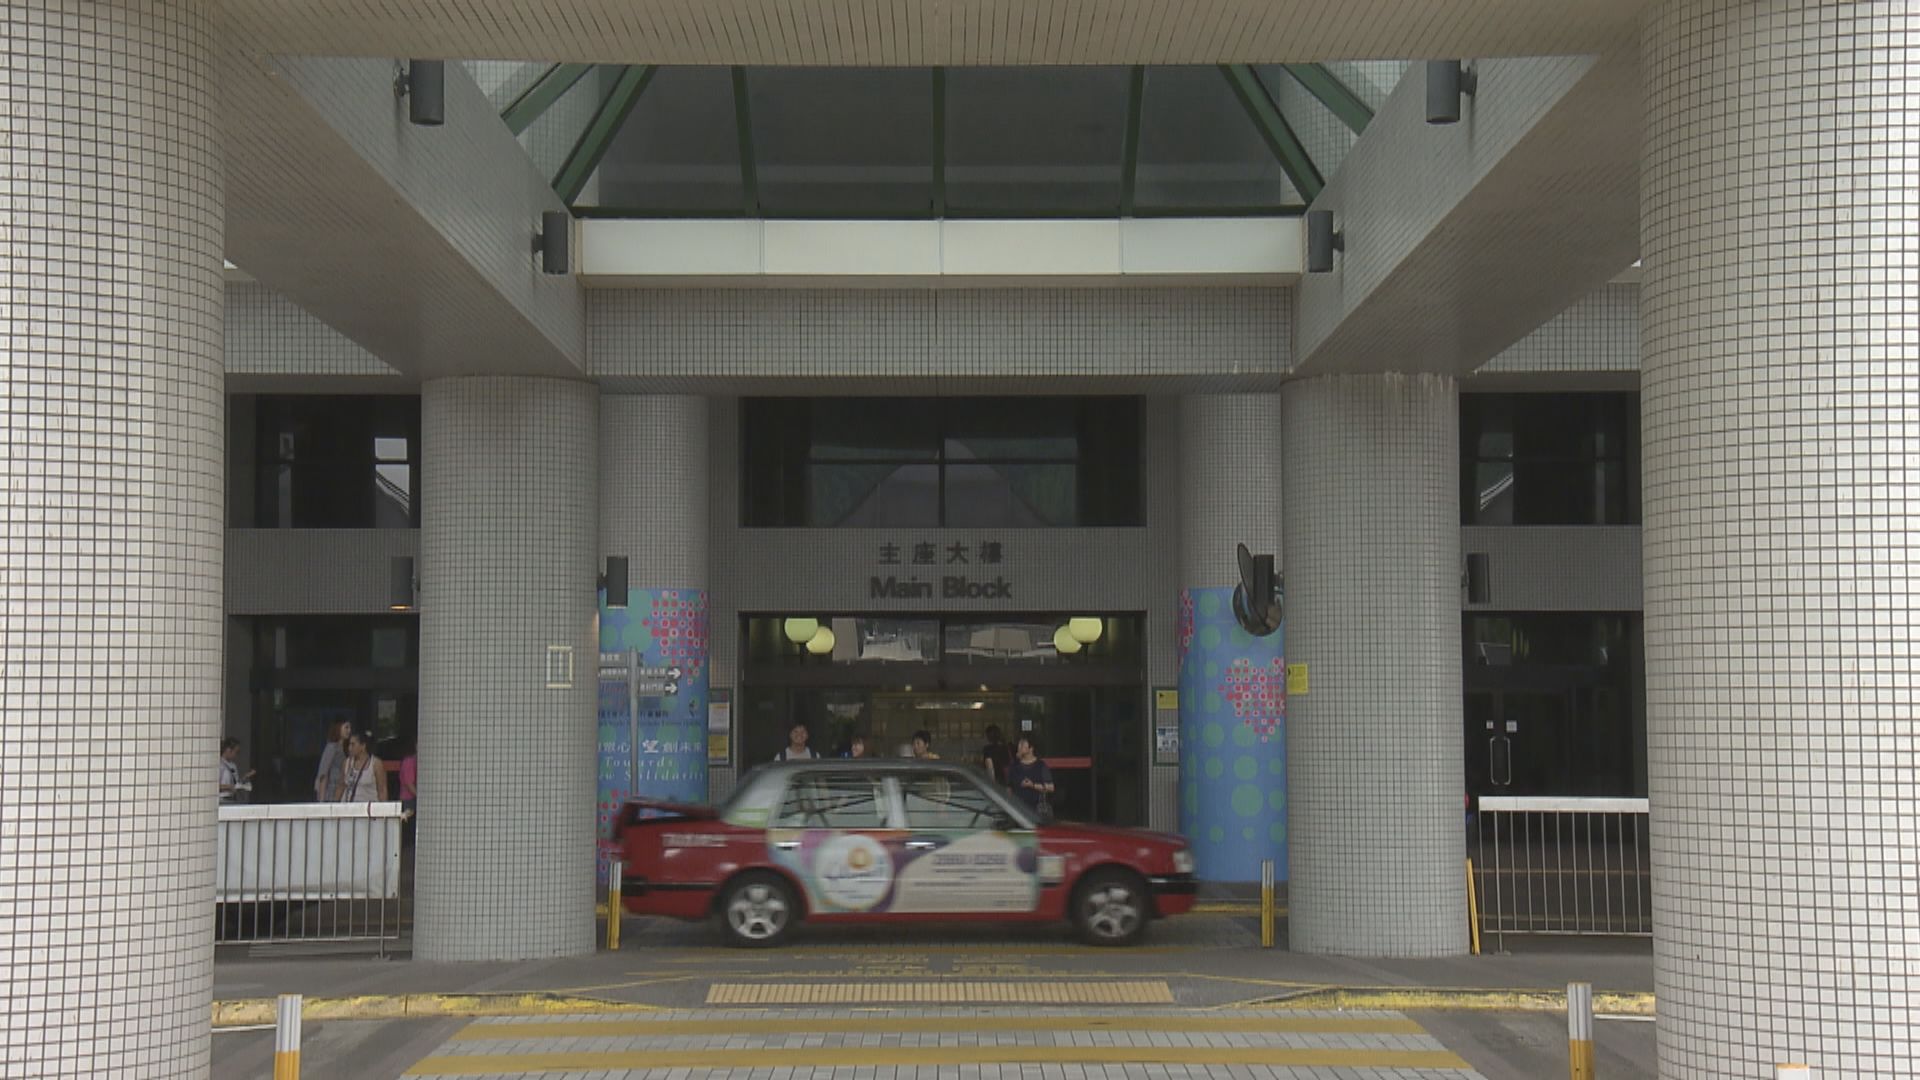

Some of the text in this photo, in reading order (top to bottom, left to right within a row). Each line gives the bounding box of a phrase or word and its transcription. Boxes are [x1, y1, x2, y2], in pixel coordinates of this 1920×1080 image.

[879, 541, 1002, 564] 主座大樓
[871, 576, 1012, 599] Main Block
